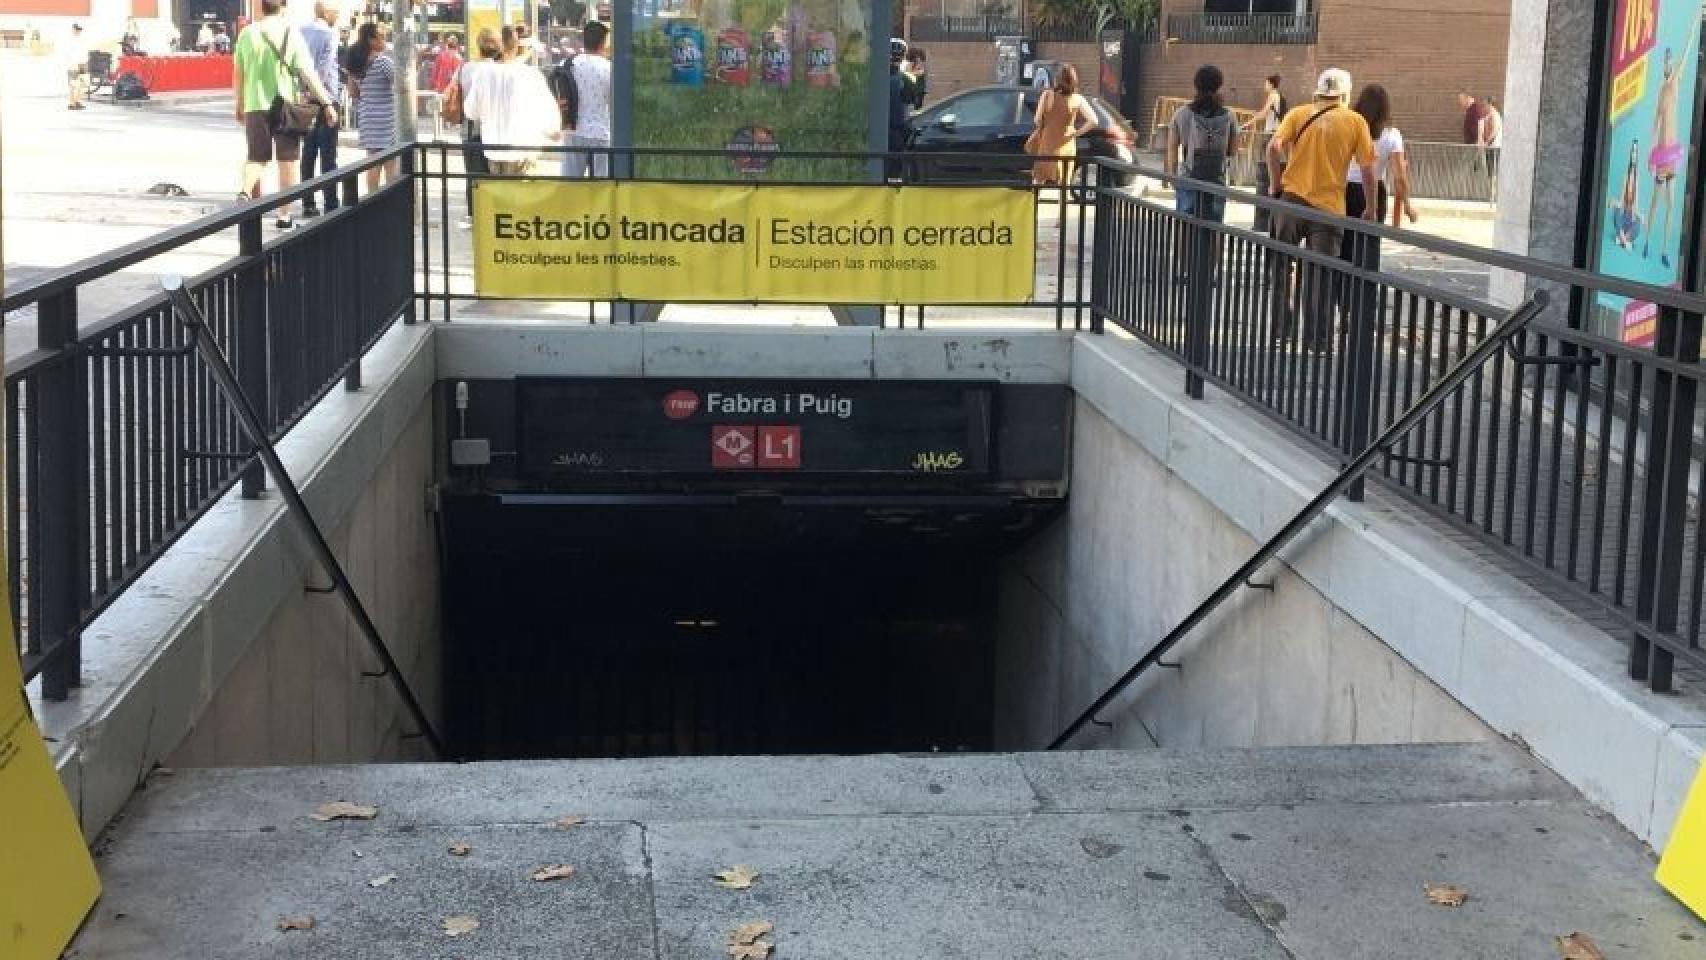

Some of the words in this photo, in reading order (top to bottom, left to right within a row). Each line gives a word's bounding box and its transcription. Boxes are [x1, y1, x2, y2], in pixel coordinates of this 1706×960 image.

[494, 213, 611, 241] Estació
[619, 215, 745, 243] tancada
[770, 217, 895, 246] Estación
[903, 219, 1013, 247] cerrada
[493, 250, 571, 267] Disculpeu
[575, 251, 599, 265] les
[603, 252, 681, 267] molesties.
[769, 255, 841, 272] Disculpen
[844, 256, 865, 270] las
[706, 393, 777, 413] Fabra
[784, 393, 791, 413] i
[799, 393, 852, 419] Puig
[765, 433, 794, 459] L1
